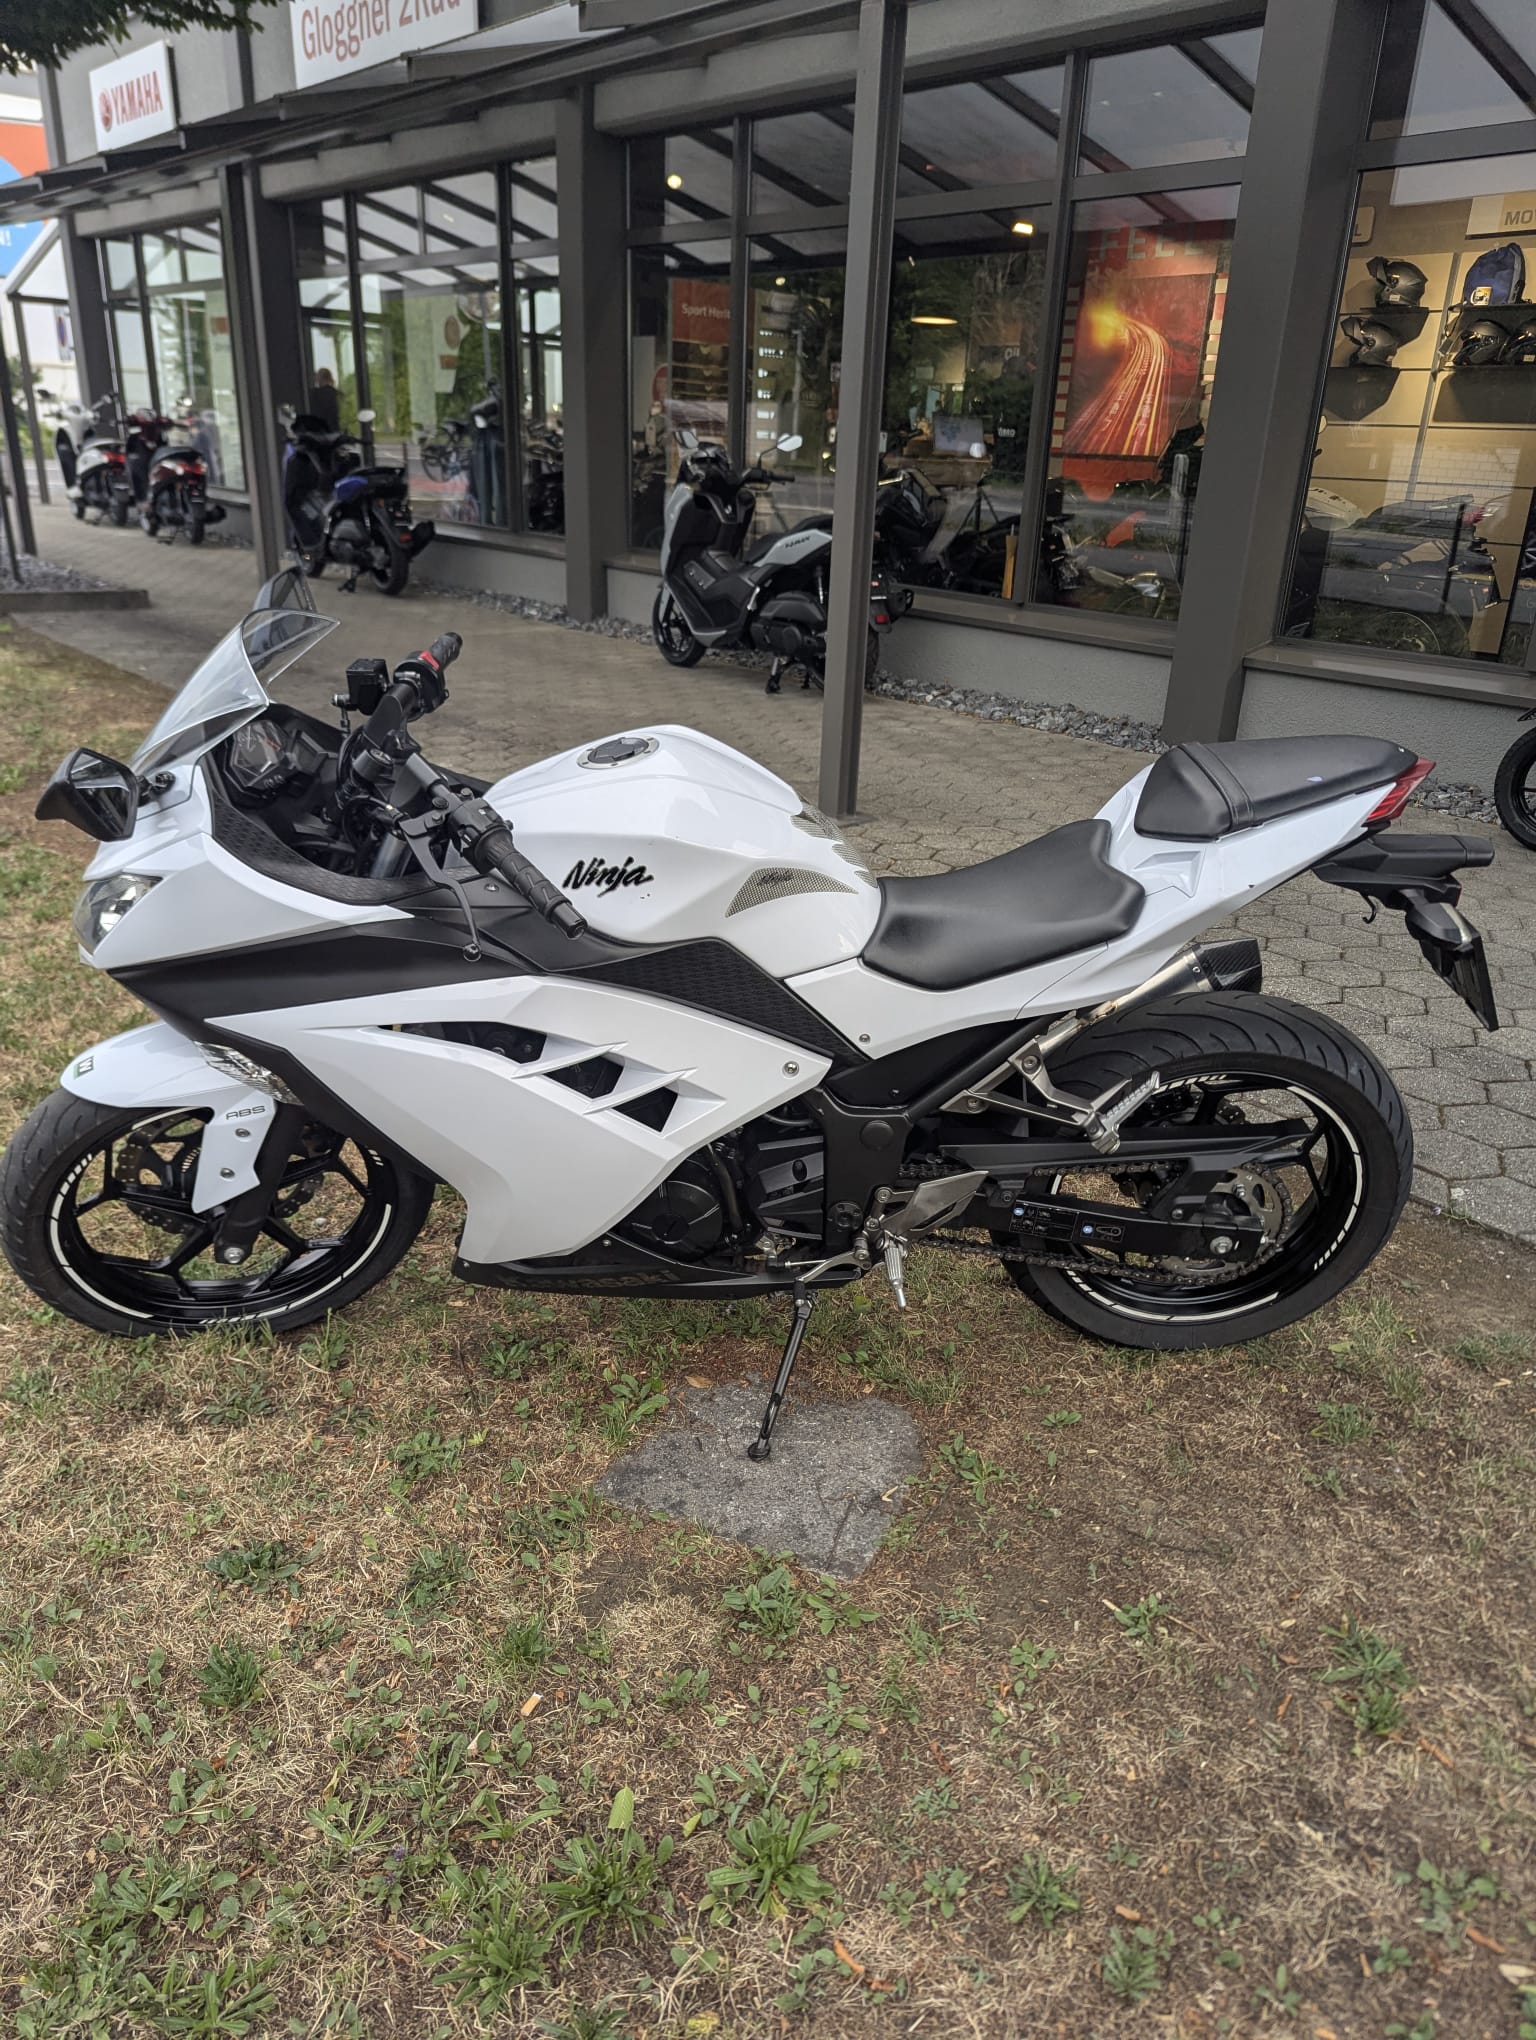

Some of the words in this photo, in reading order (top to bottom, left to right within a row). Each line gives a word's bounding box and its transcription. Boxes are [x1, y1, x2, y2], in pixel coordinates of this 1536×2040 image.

[301, 0, 390, 62] Gloggner
[111, 70, 163, 126] YAMAHA
[1504, 209, 1536, 226] MO
[681, 303, 707, 318] Sport
[562, 856, 654, 897] Ninja
[226, 1105, 266, 1120] ABS
